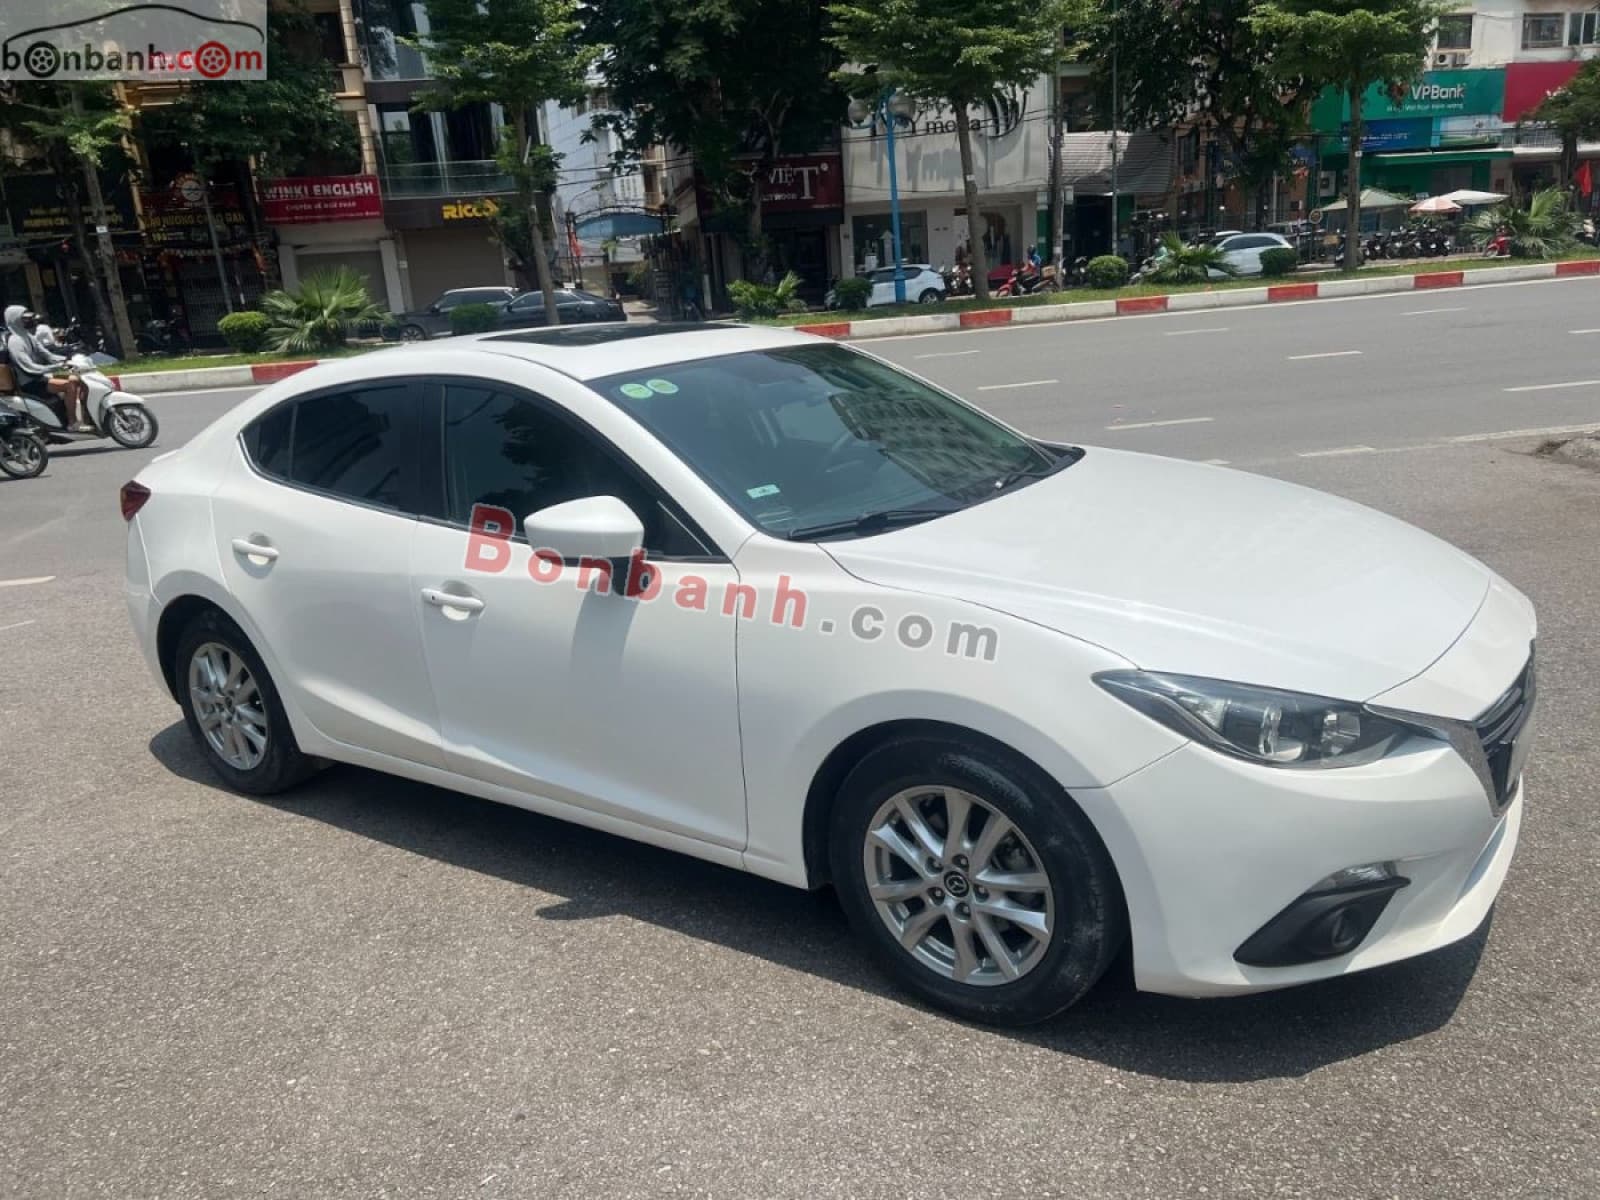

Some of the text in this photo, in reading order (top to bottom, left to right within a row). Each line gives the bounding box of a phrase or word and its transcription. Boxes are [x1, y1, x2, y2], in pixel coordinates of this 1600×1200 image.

[1411, 85, 1465, 101] VPBank
[926, 118, 979, 134] moa
[312, 181, 374, 197] ENGLISH
